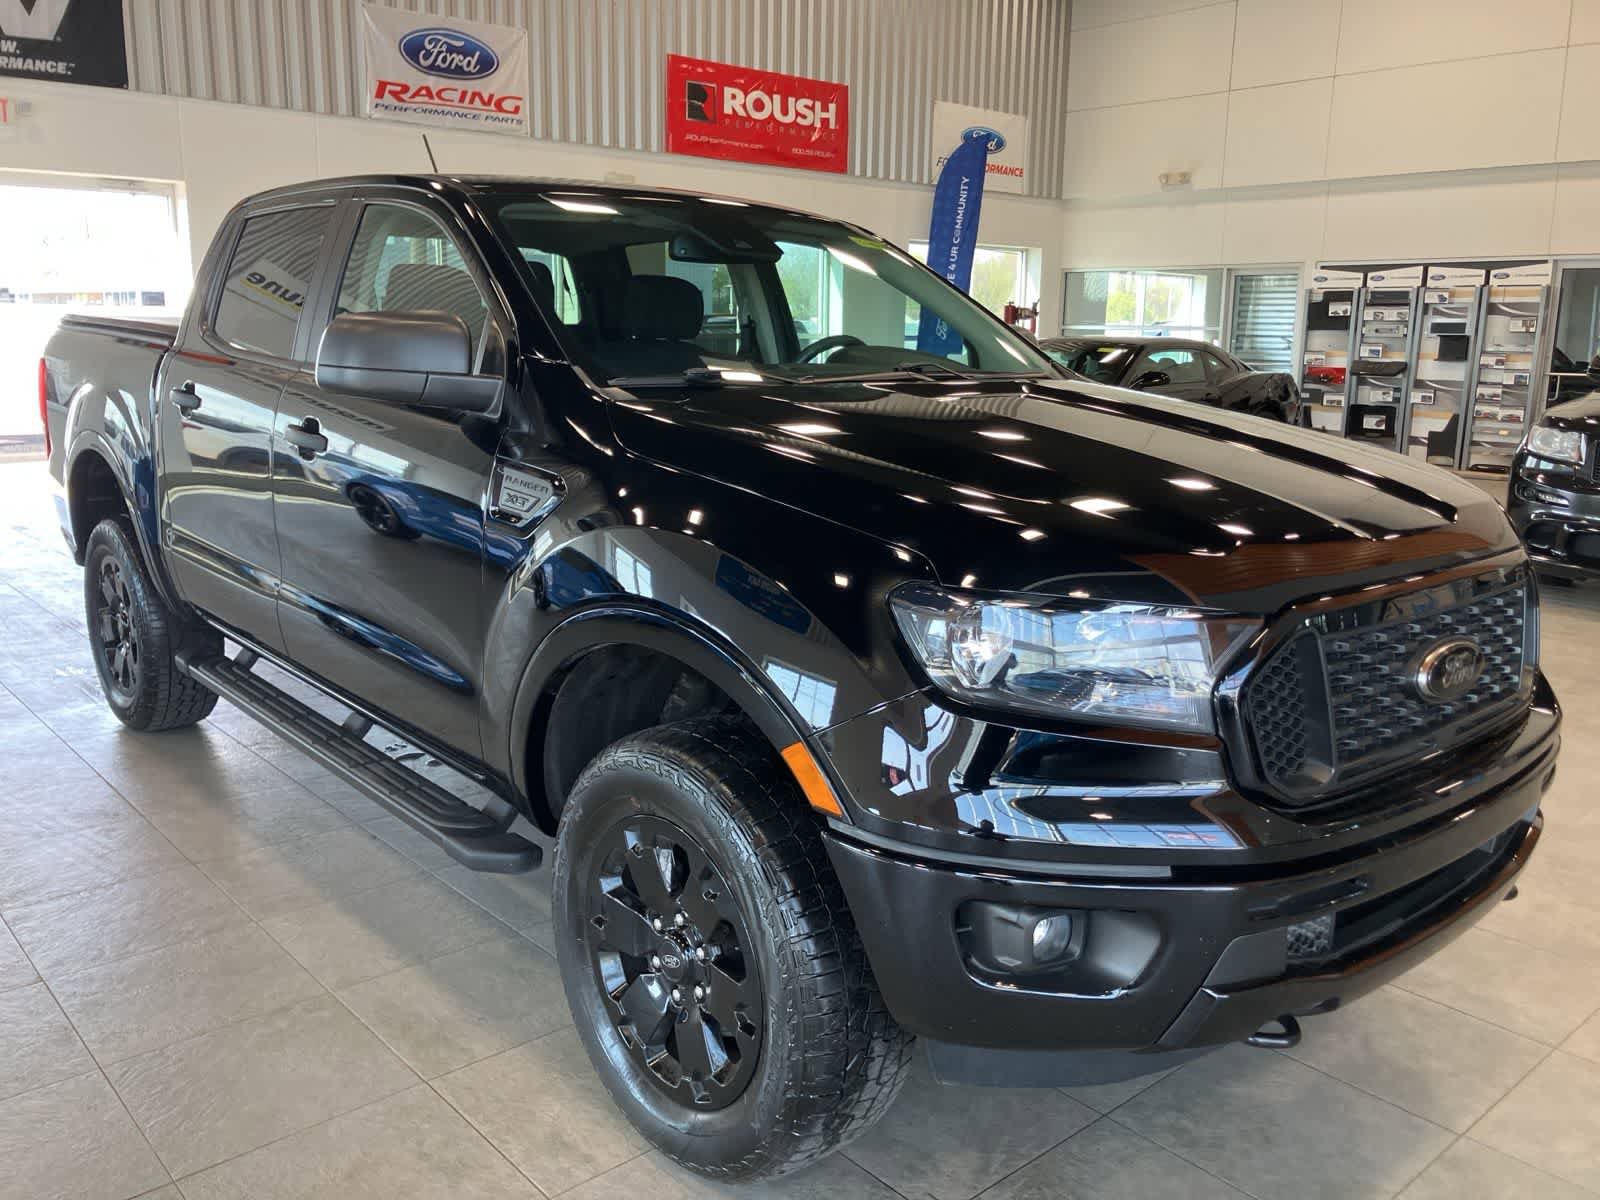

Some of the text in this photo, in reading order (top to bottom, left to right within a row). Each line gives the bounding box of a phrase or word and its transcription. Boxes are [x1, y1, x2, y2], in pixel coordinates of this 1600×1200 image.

[419, 35, 481, 73] Ford
[374, 80, 523, 115] RACING
[374, 103, 524, 126] PERFORMANCE PARTS
[723, 86, 837, 129] ROUSH
[952, 176, 970, 244] COMMUNITY
[949, 246, 959, 262] UR
[504, 474, 549, 494] RANGER
